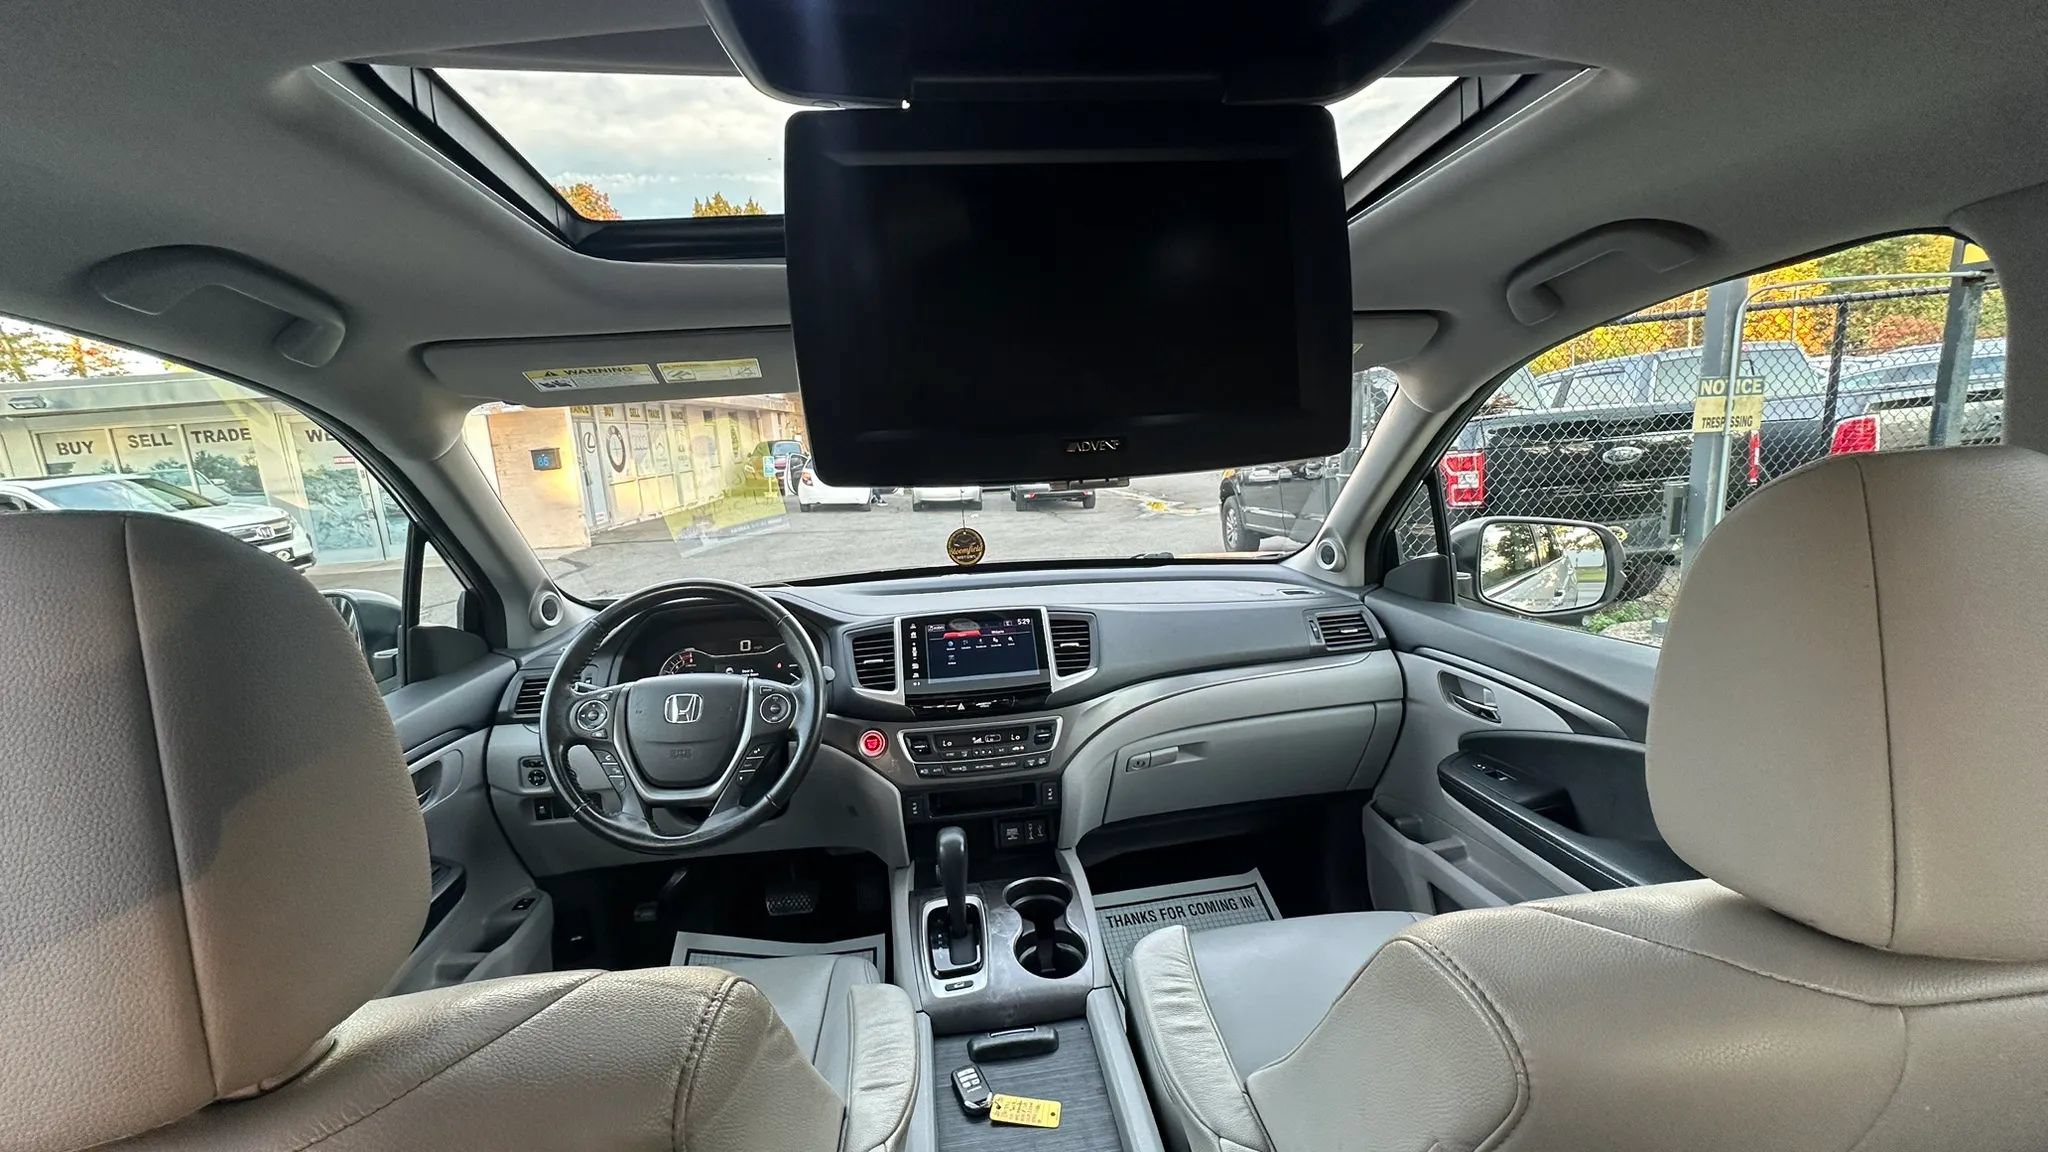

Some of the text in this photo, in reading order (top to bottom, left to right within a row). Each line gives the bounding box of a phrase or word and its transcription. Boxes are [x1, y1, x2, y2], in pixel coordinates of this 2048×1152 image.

[563, 366, 632, 376] WARNING
[1700, 380, 1763, 395] NOICE
[1701, 416, 1753, 429] TRESPSSING
[127, 433, 173, 448] SELL
[190, 427, 252, 444] TRADE
[56, 440, 94, 456] BUY
[1105, 896, 1255, 929] THANKS FOR COMING IN
